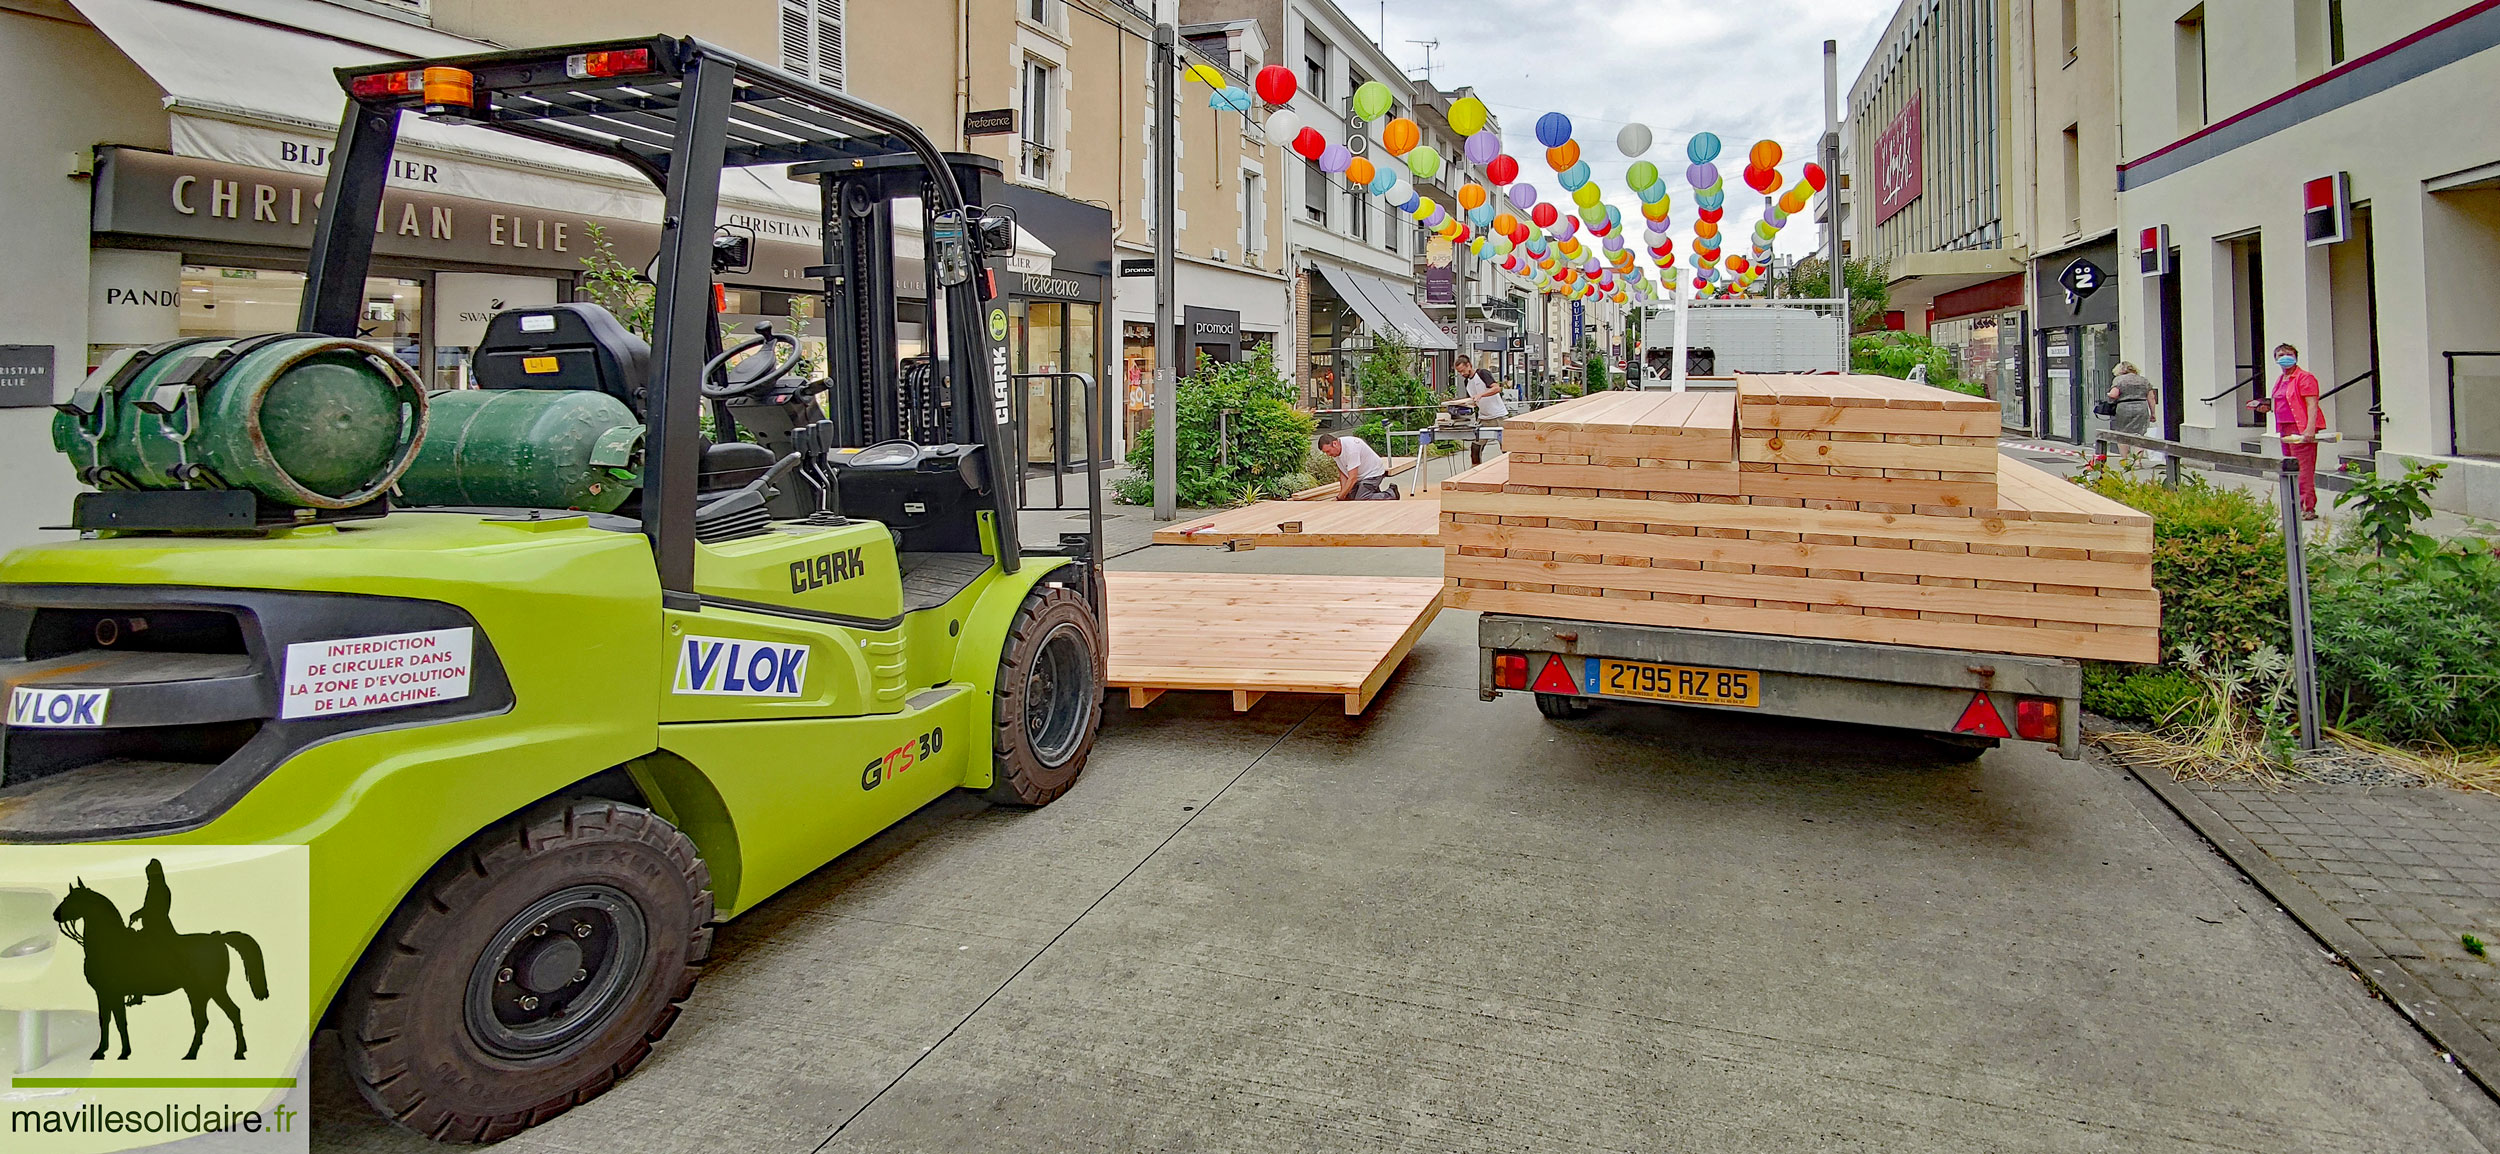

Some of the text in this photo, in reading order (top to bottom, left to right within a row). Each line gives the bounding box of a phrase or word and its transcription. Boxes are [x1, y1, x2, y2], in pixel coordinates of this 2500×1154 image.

[967, 117, 1011, 129] Preference
[280, 141, 439, 184] BIJIER
[172, 176, 568, 252] CHRIIAN ELIE
[730, 214, 810, 239] CHRISTIAN
[1022, 273, 1080, 297] Preference
[1195, 322, 1234, 335] promod
[1, 378, 26, 387] ELIE
[993, 346, 1009, 425] CLARK
[790, 547, 865, 595] CLARK
[328, 636, 436, 657] INTERDICTION
[308, 651, 452, 677] DE CIRCULER DANS
[688, 640, 805, 693] VLOK
[290, 666, 466, 696] LA ZONE D'EVOLUTION
[1589, 678, 1596, 686] F
[1611, 664, 1671, 693] 2795
[1679, 670, 1709, 696] RZ
[1717, 673, 1748, 699] 85
[15, 691, 102, 724] VLOK
[315, 686, 441, 711] DE LA MACHINE.
[862, 727, 943, 791] GTS 30
